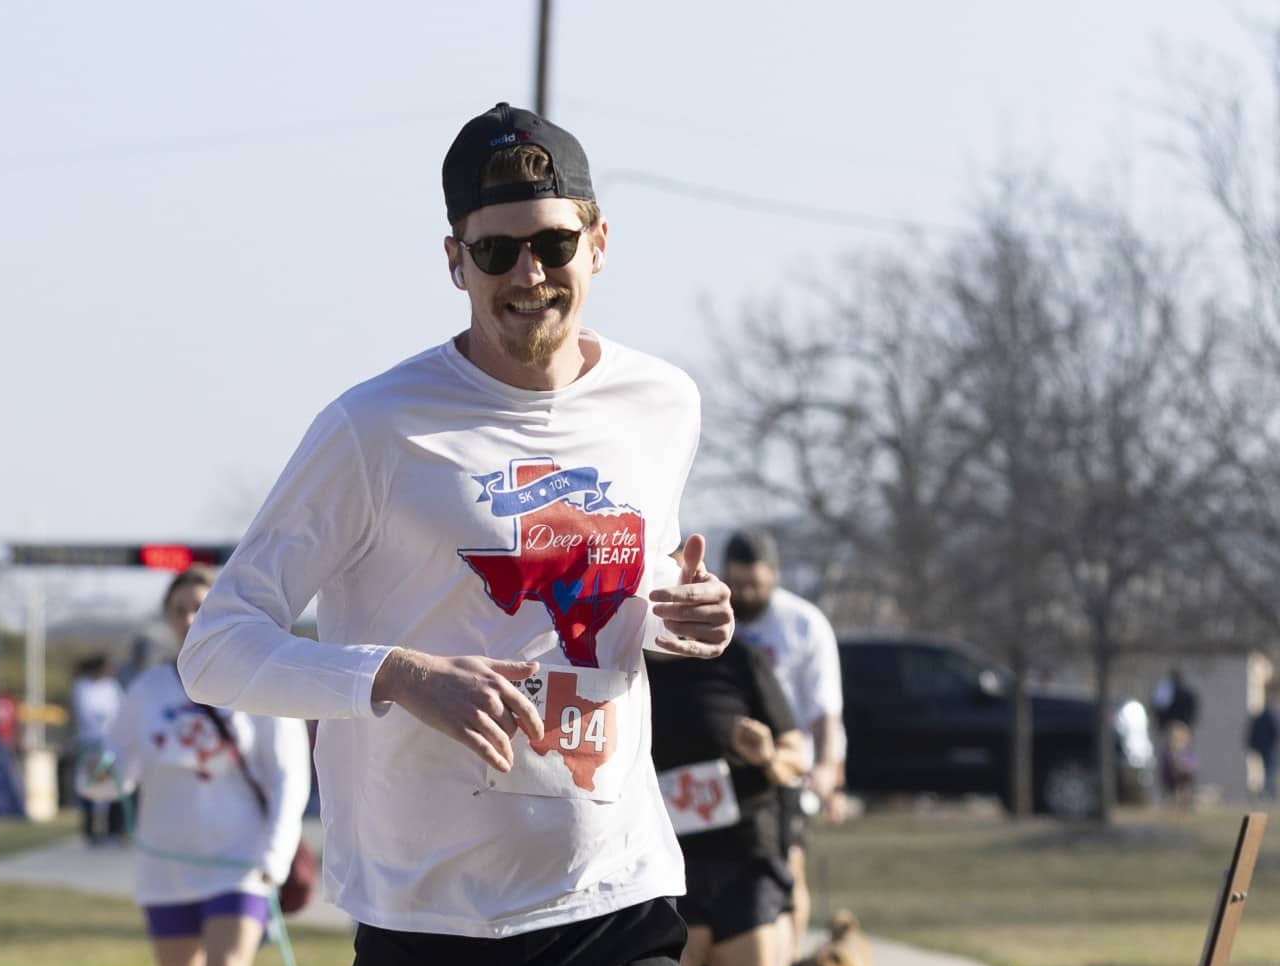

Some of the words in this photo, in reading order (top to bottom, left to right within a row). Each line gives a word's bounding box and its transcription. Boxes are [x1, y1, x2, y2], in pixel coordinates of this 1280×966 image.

[519, 491, 533, 504] 5K
[549, 476, 570, 493] 10K
[525, 524, 583, 554] Deep
[587, 530, 608, 546] in
[610, 527, 637, 546] the
[587, 547, 640, 565] HEART
[559, 706, 607, 752] 94
